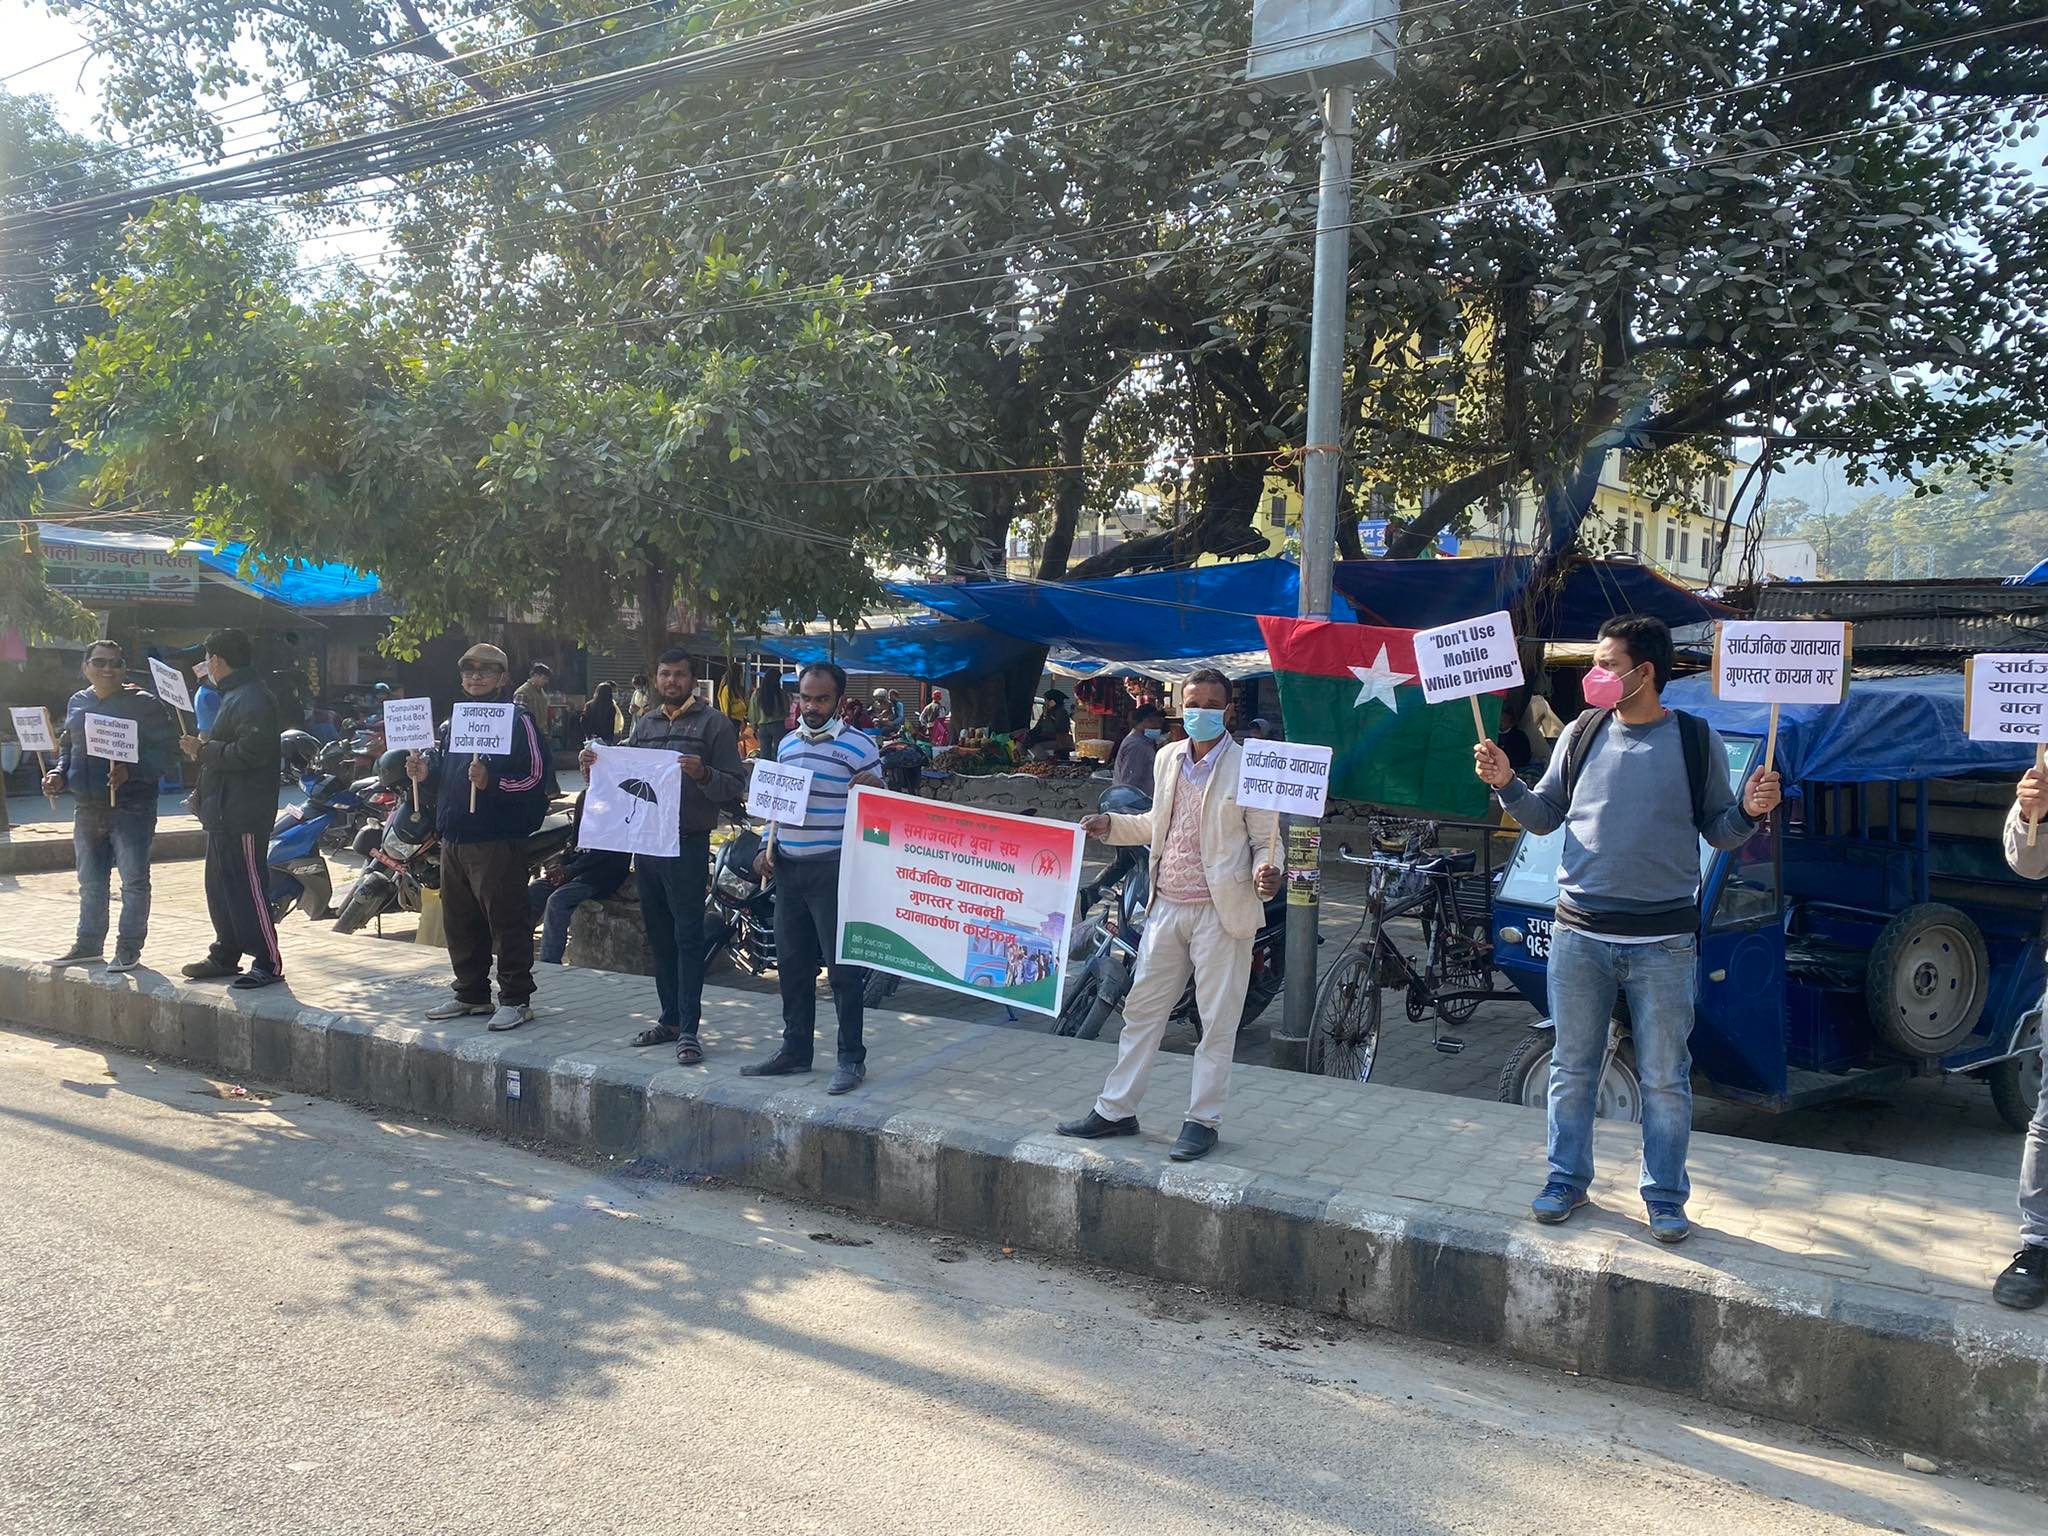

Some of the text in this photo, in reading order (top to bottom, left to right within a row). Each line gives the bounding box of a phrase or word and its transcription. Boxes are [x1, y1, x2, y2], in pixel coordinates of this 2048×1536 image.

[1430, 625, 1496, 648] "Don't Use
[1790, 640, 1841, 656] यातायात
[1443, 647, 1489, 668] Mobile
[1425, 660, 1518, 692] While Driving"
[1726, 667, 1771, 687] गुणस्तर
[1775, 669, 1813, 684] कायम
[2000, 702, 2043, 715] बाल
[402, 724, 420, 732] Public
[468, 722, 490, 733] Horn
[2000, 722, 2042, 735] बन्द
[1246, 751, 1328, 776] सार्वजनिक यातायात
[1243, 777, 1322, 800] गुणस्तर कायम गर
[904, 823, 966, 849] समाजवादी
[970, 836, 994, 856] युवा
[904, 843, 1015, 874] SOCIALIST YOUTH UNION
[896, 865, 1024, 904] सार्वजनिक यातायातको
[910, 890, 1006, 921] गुणस्तर सम्बन्धी
[896, 907, 1018, 945] ध्यानाकर्षण कार्यक्रम
